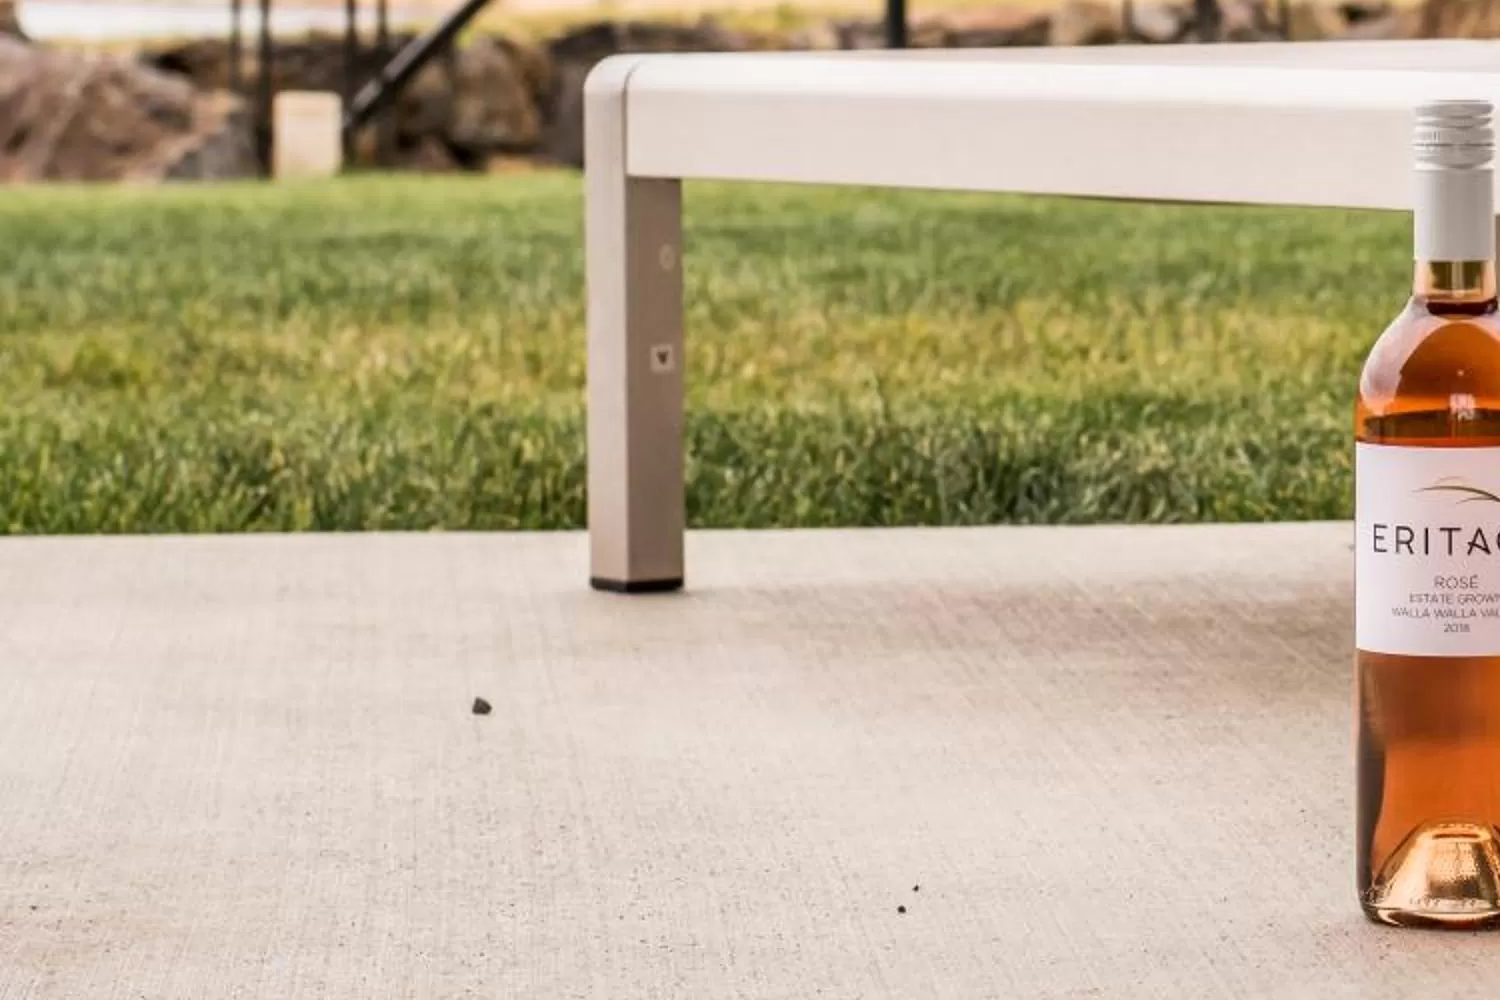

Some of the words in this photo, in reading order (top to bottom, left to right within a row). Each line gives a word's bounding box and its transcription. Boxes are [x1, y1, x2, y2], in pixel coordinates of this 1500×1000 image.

[1434, 574, 1480, 589] ROSÉ
[1409, 593, 1453, 604] ESTATE
[1391, 607, 1430, 619] WALLA
[1433, 608, 1477, 619] WALLA
